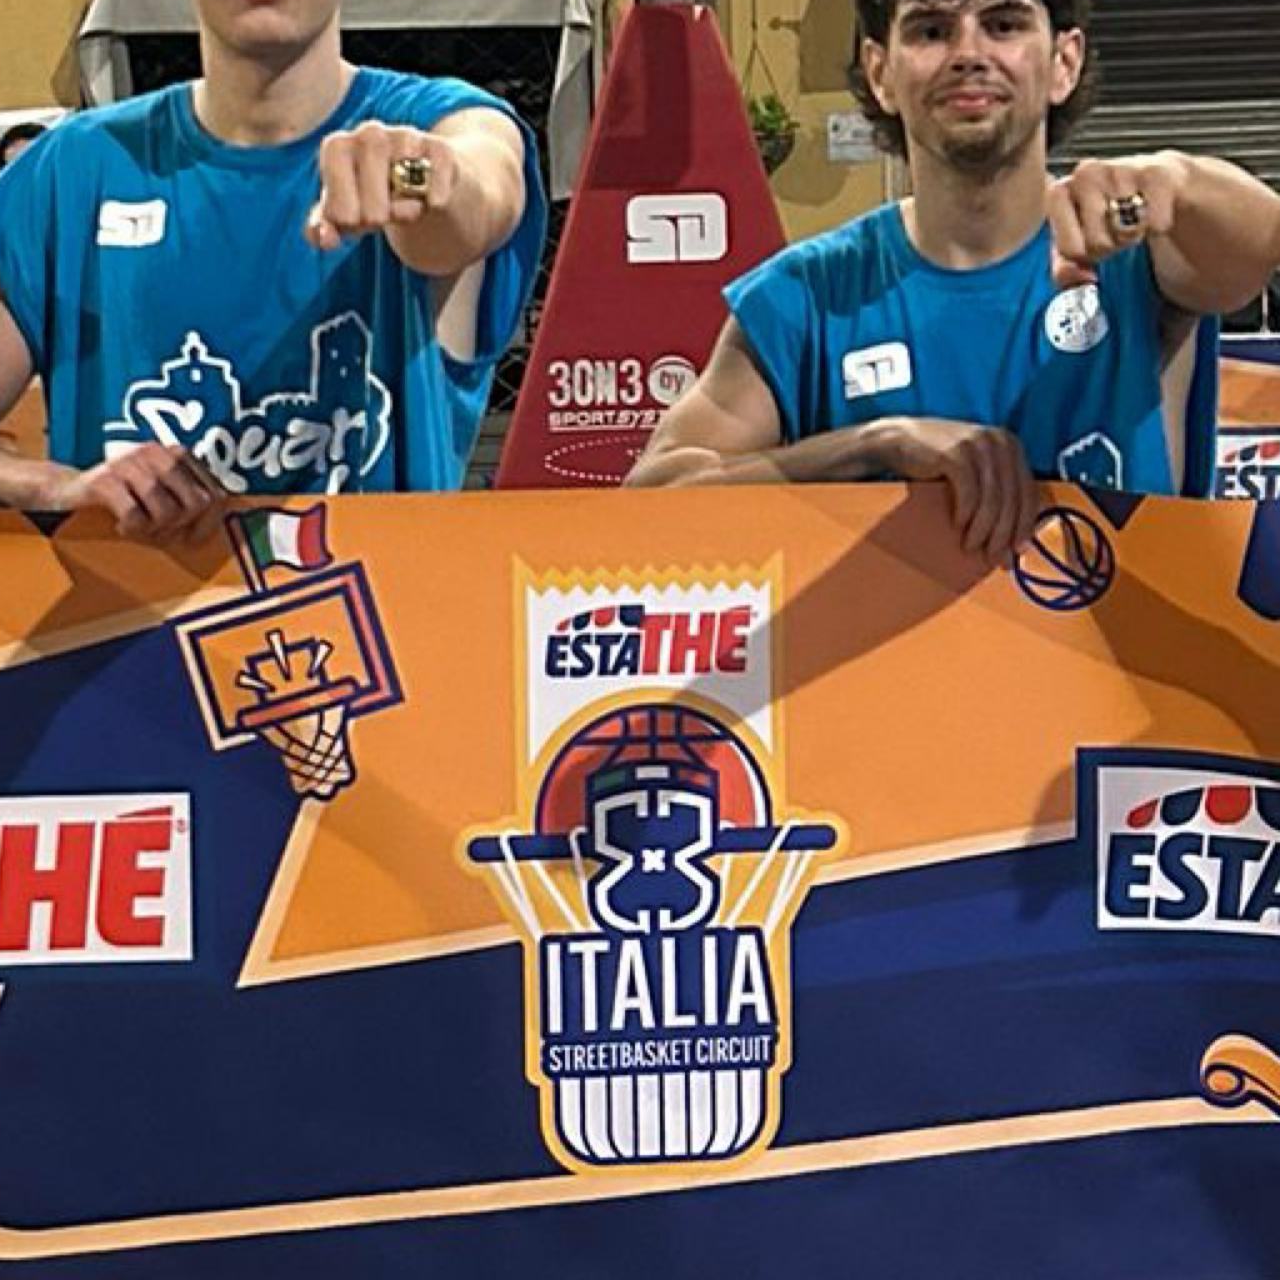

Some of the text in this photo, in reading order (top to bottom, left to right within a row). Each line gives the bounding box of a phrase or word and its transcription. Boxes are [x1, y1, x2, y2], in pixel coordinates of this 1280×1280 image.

[546, 933, 771, 1035] ITALIA
[548, 1034, 771, 1072] STREETBASKET CIRCUIT
